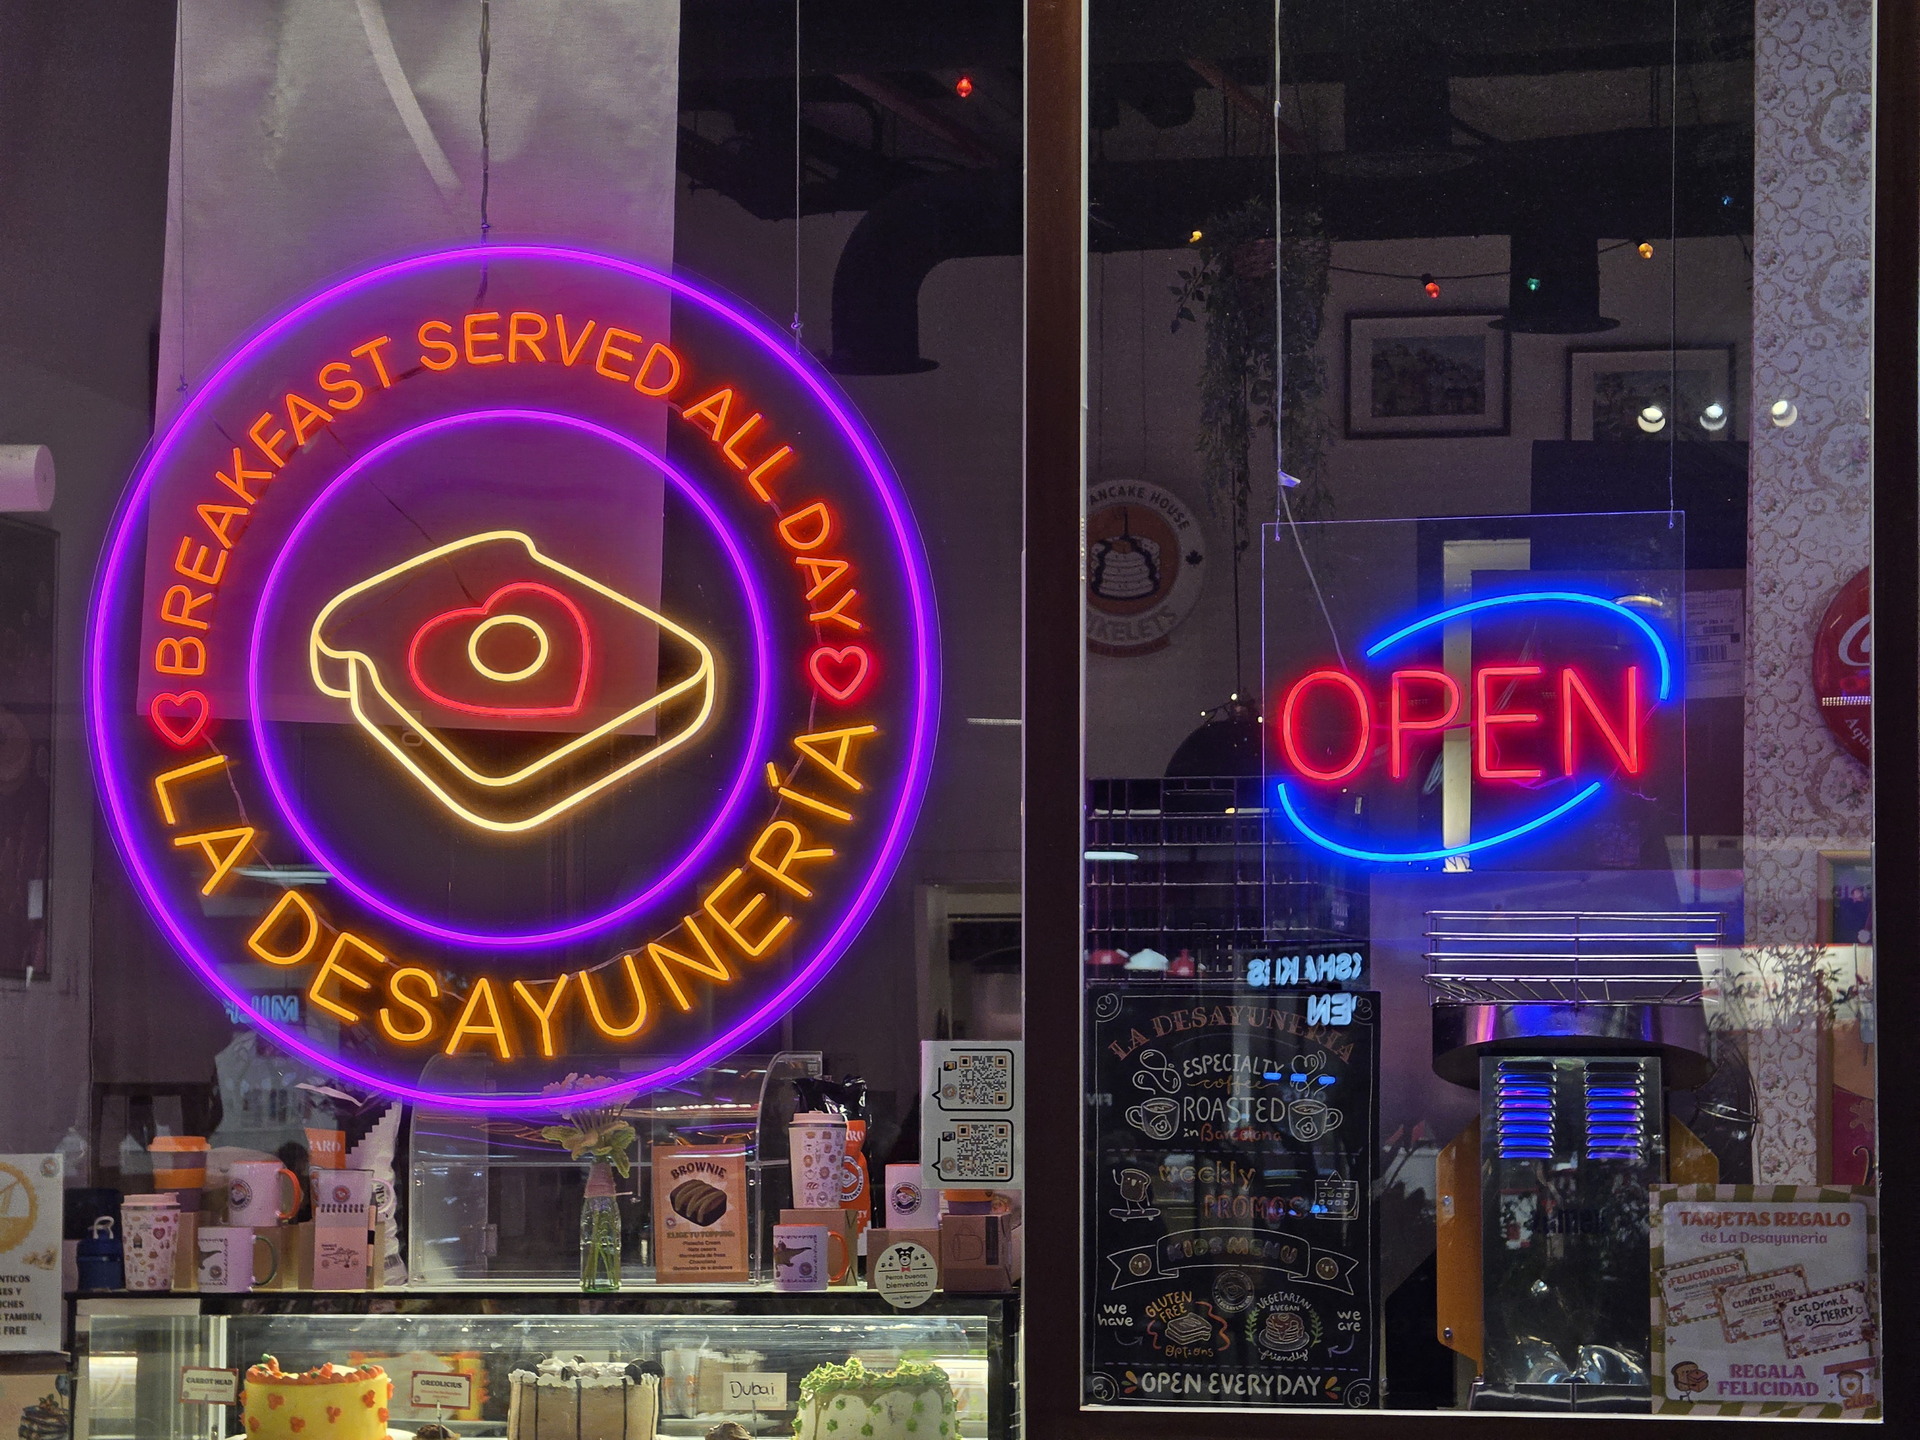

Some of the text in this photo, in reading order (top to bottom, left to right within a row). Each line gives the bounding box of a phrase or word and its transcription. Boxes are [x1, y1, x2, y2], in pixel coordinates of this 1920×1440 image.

[155, 312, 863, 677] BREAKFAST SERVED ALL DAY
[1149, 491, 1191, 531] HOUSE
[1282, 665, 1641, 780] OPEN
[155, 724, 879, 1059] LA DESAYUNERÍA
[1107, 1027, 1150, 1061] LA
[1183, 1053, 1285, 1078] ESPECIALTY
[1186, 1077, 1279, 1094] coffee
[1183, 1096, 1286, 1123] ROASTED
[1183, 1122, 1282, 1142] in Barcelona
[670, 1161, 728, 1180] BROWNIE
[1158, 1159, 1257, 1190] weekly
[1203, 1193, 1307, 1220] PROMOS
[1679, 1211, 1851, 1229] TARJETAS REGALO
[1700, 1232, 1717, 1243] de
[1720, 1232, 1737, 1243] La
[1167, 1236, 1299, 1265] KIDS MENU
[886, 1281, 929, 1289] bienvenidos
[1763, 1283, 1776, 1292] TU
[1145, 1290, 1193, 1319] GLUTEN
[1256, 1290, 1312, 1310] VEGETARIAN
[1732, 1288, 1796, 1309] CUMPLEAÑOS!
[1812, 1298, 1839, 1311] Drink
[1103, 1302, 1128, 1315] we
[1158, 1302, 1188, 1323] FREE
[1337, 1309, 1362, 1321] we
[1804, 1305, 1854, 1327] BE MERRY
[4, 1326, 27, 1335] FREE
[1097, 1314, 1134, 1328] have
[1337, 1321, 1362, 1332] are
[1762, 1318, 1778, 1327] 25€
[185, 1377, 214, 1385] CARROT
[1729, 1364, 1806, 1379] REGALA
[729, 1380, 775, 1399] Dubai
[1141, 1372, 1202, 1394] OPEN
[1717, 1380, 1819, 1397] FELICIDAD
